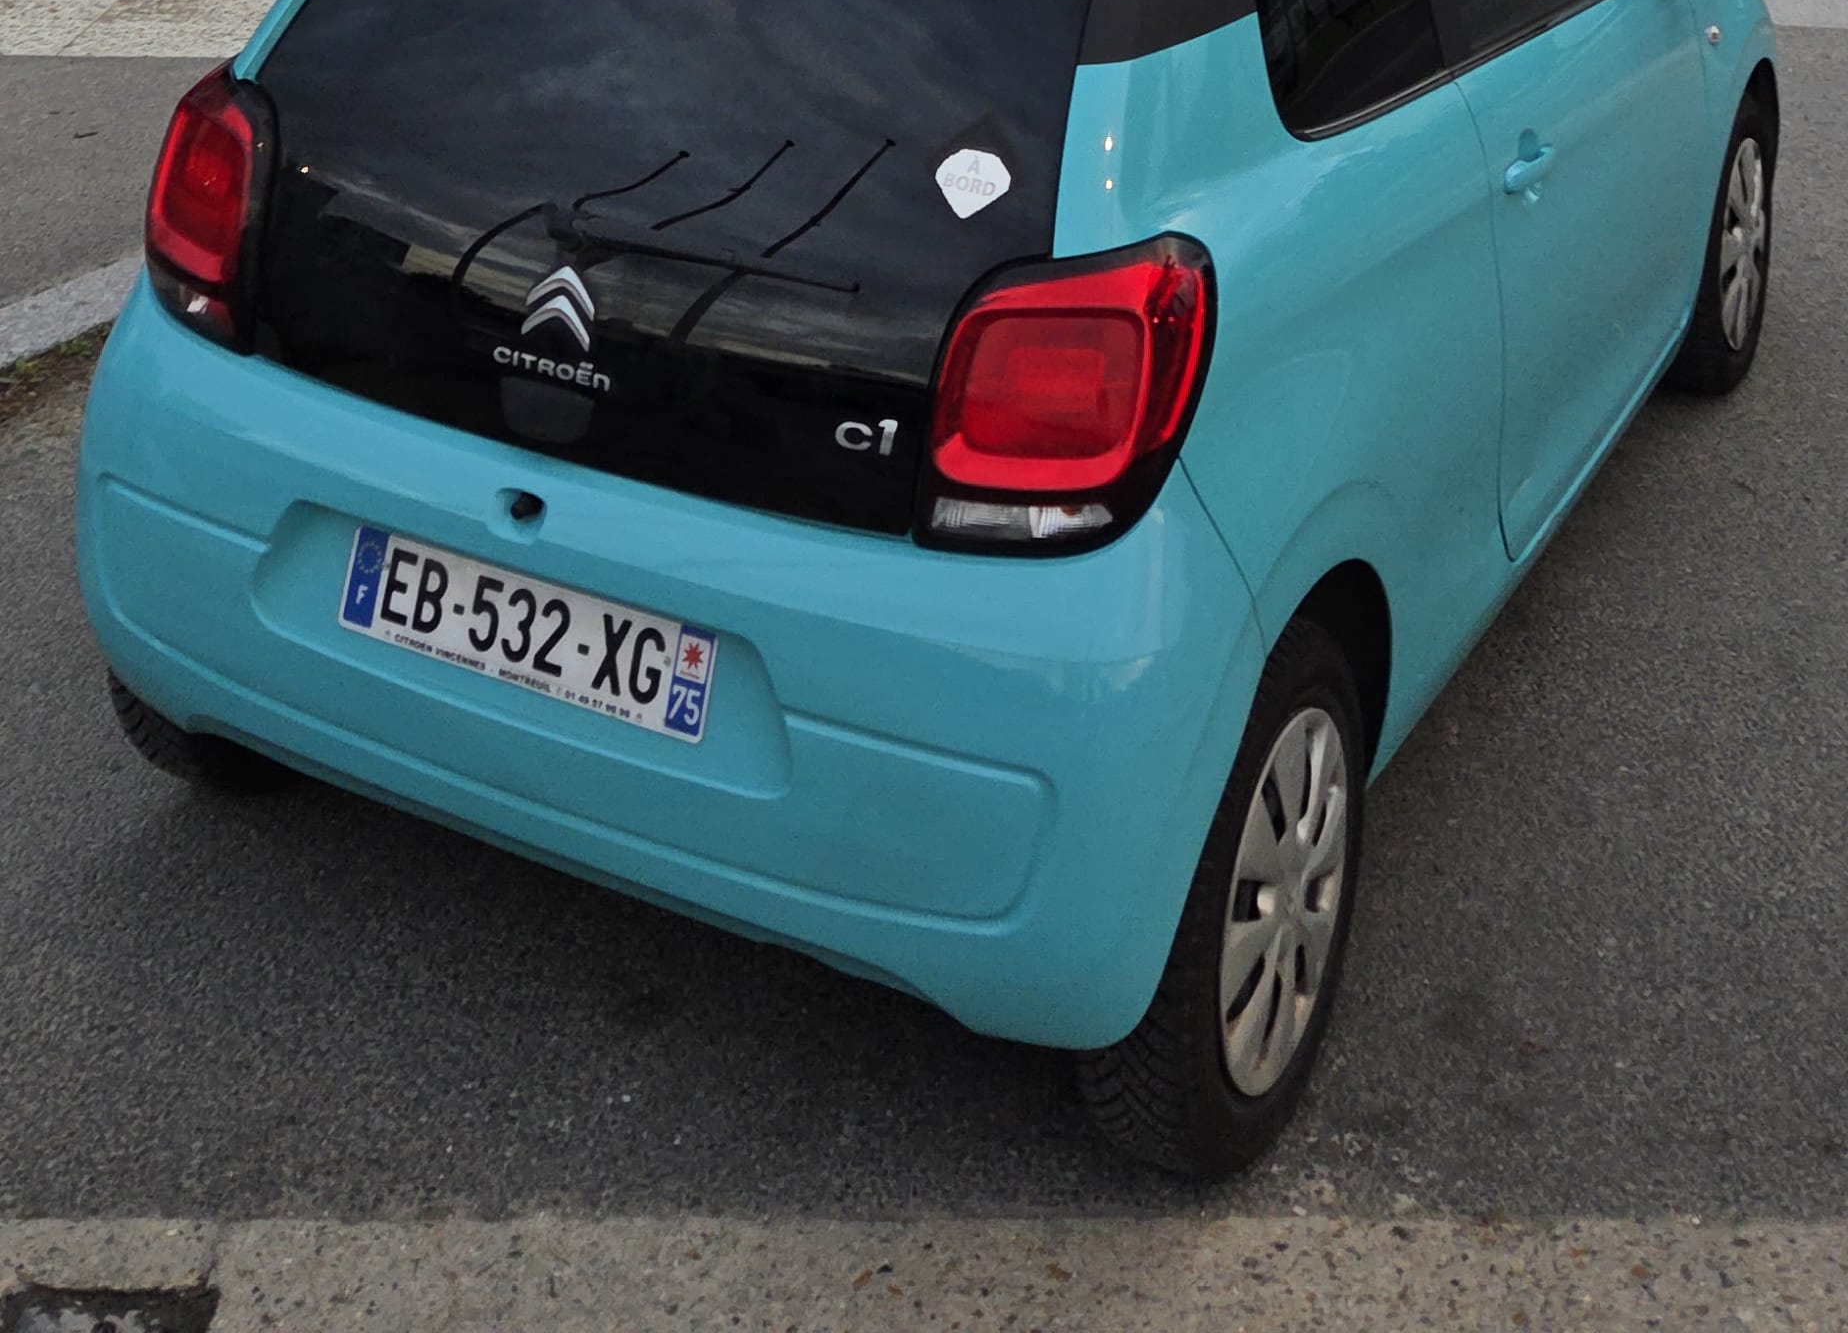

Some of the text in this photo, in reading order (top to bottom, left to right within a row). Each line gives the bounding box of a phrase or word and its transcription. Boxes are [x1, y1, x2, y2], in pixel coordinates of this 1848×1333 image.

[943, 172, 997, 197] BORD
[492, 345, 611, 392] CITROËN
[834, 418, 899, 456] C1
[354, 584, 369, 606] F
[380, 547, 667, 705] EB-532-XG
[667, 684, 702, 726] 75
